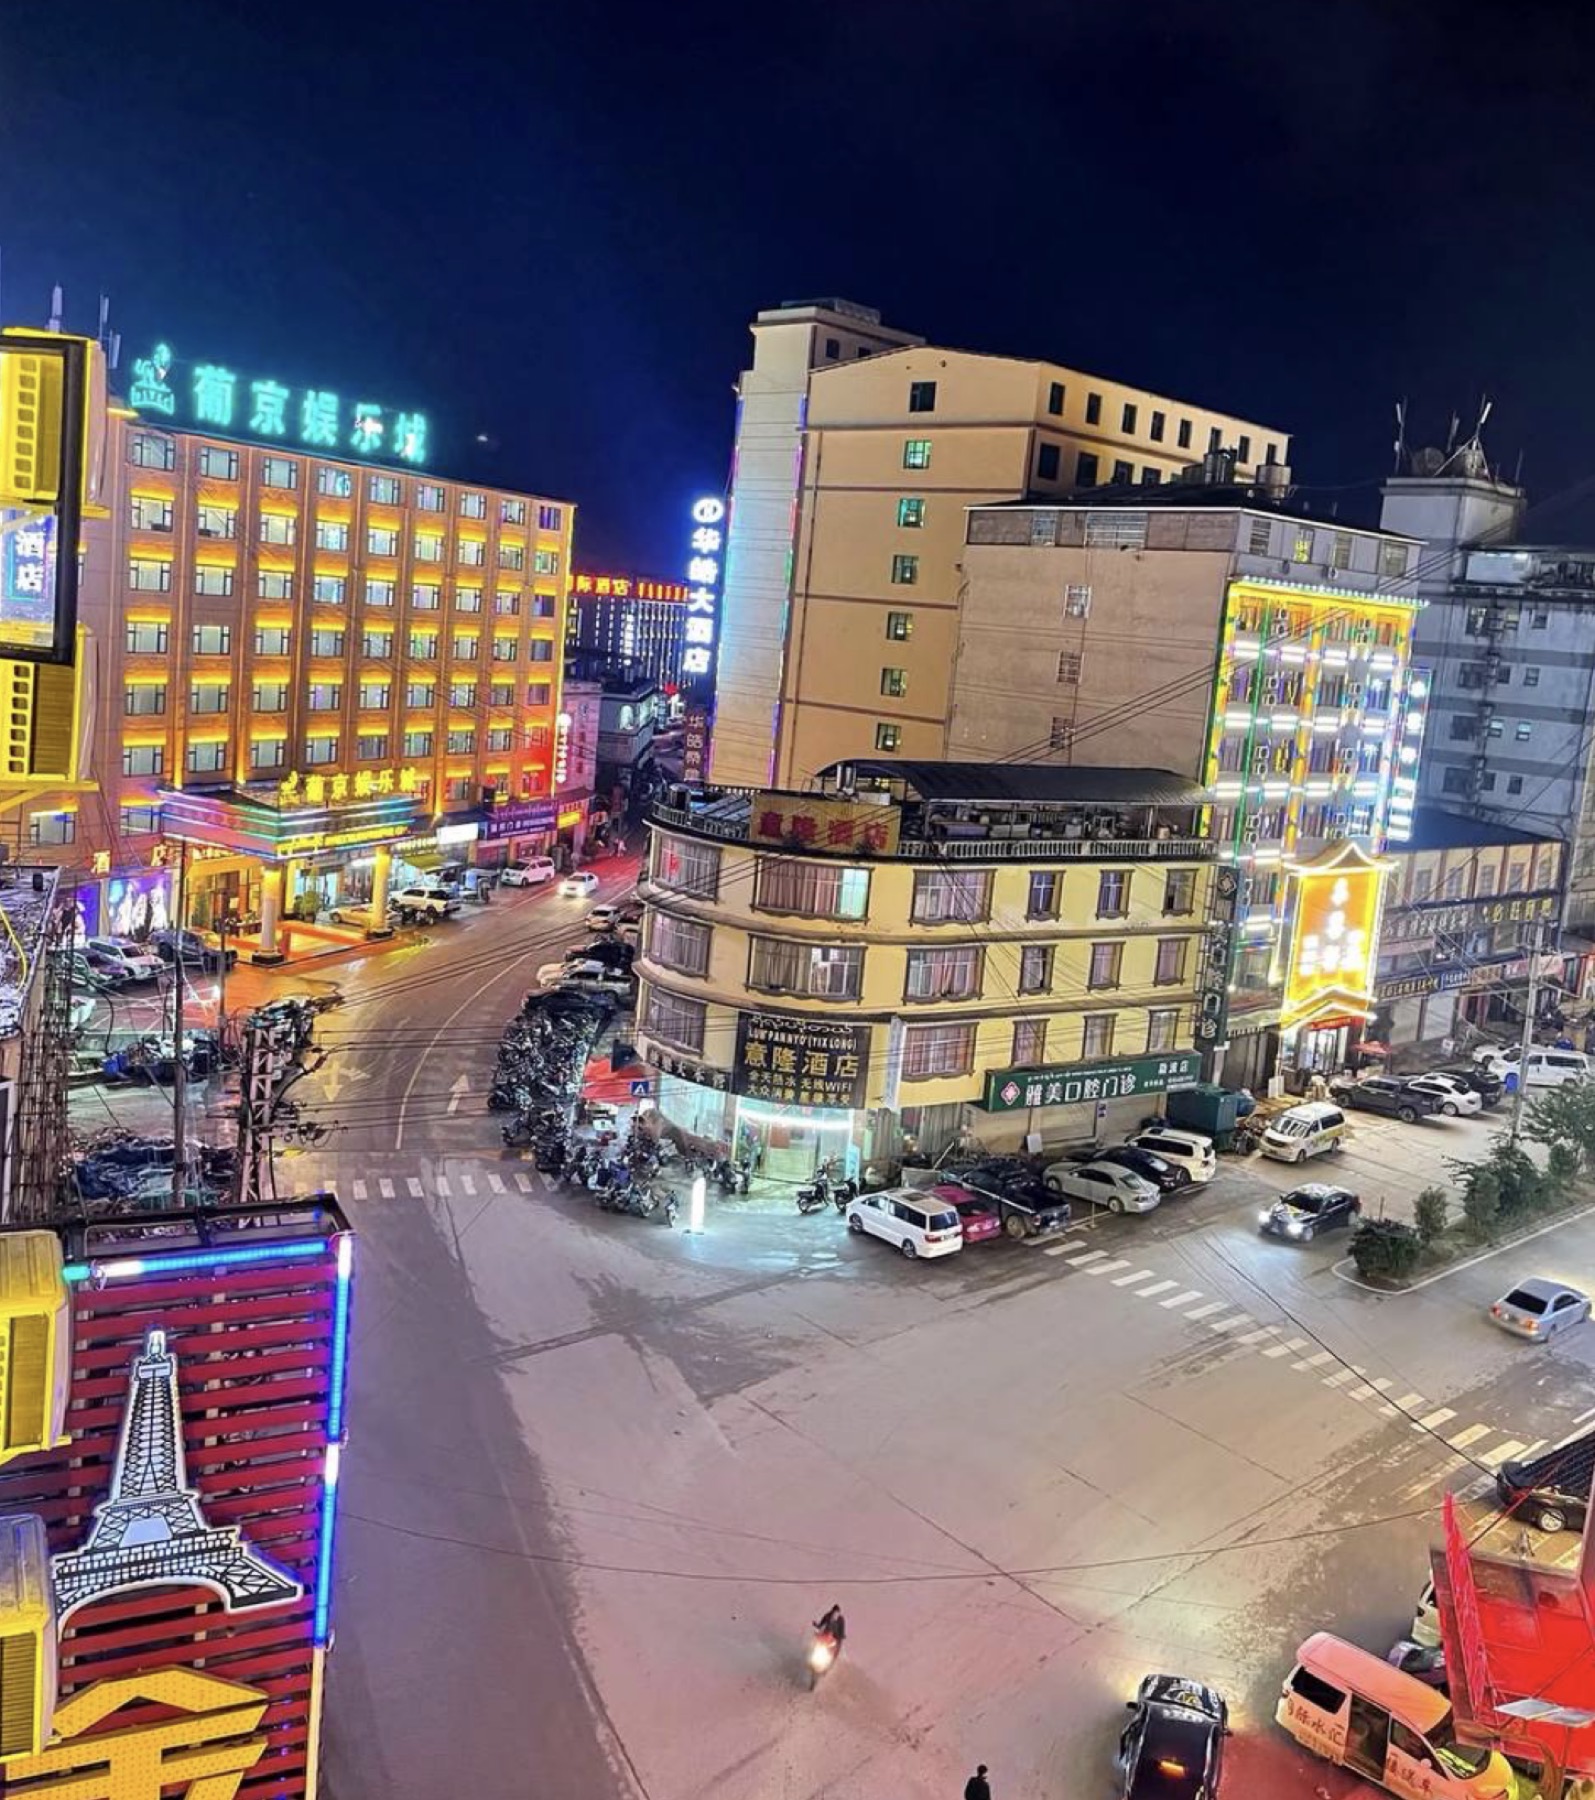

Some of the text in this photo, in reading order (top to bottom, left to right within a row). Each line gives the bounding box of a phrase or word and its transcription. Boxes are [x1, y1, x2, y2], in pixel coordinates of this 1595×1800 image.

[194, 364, 427, 463] 葡京娱乐城
[305, 767, 416, 802] 葡京娱乐城
[759, 811, 888, 850] 意隆酒店
[744, 1041, 860, 1078] 意隆酒店
